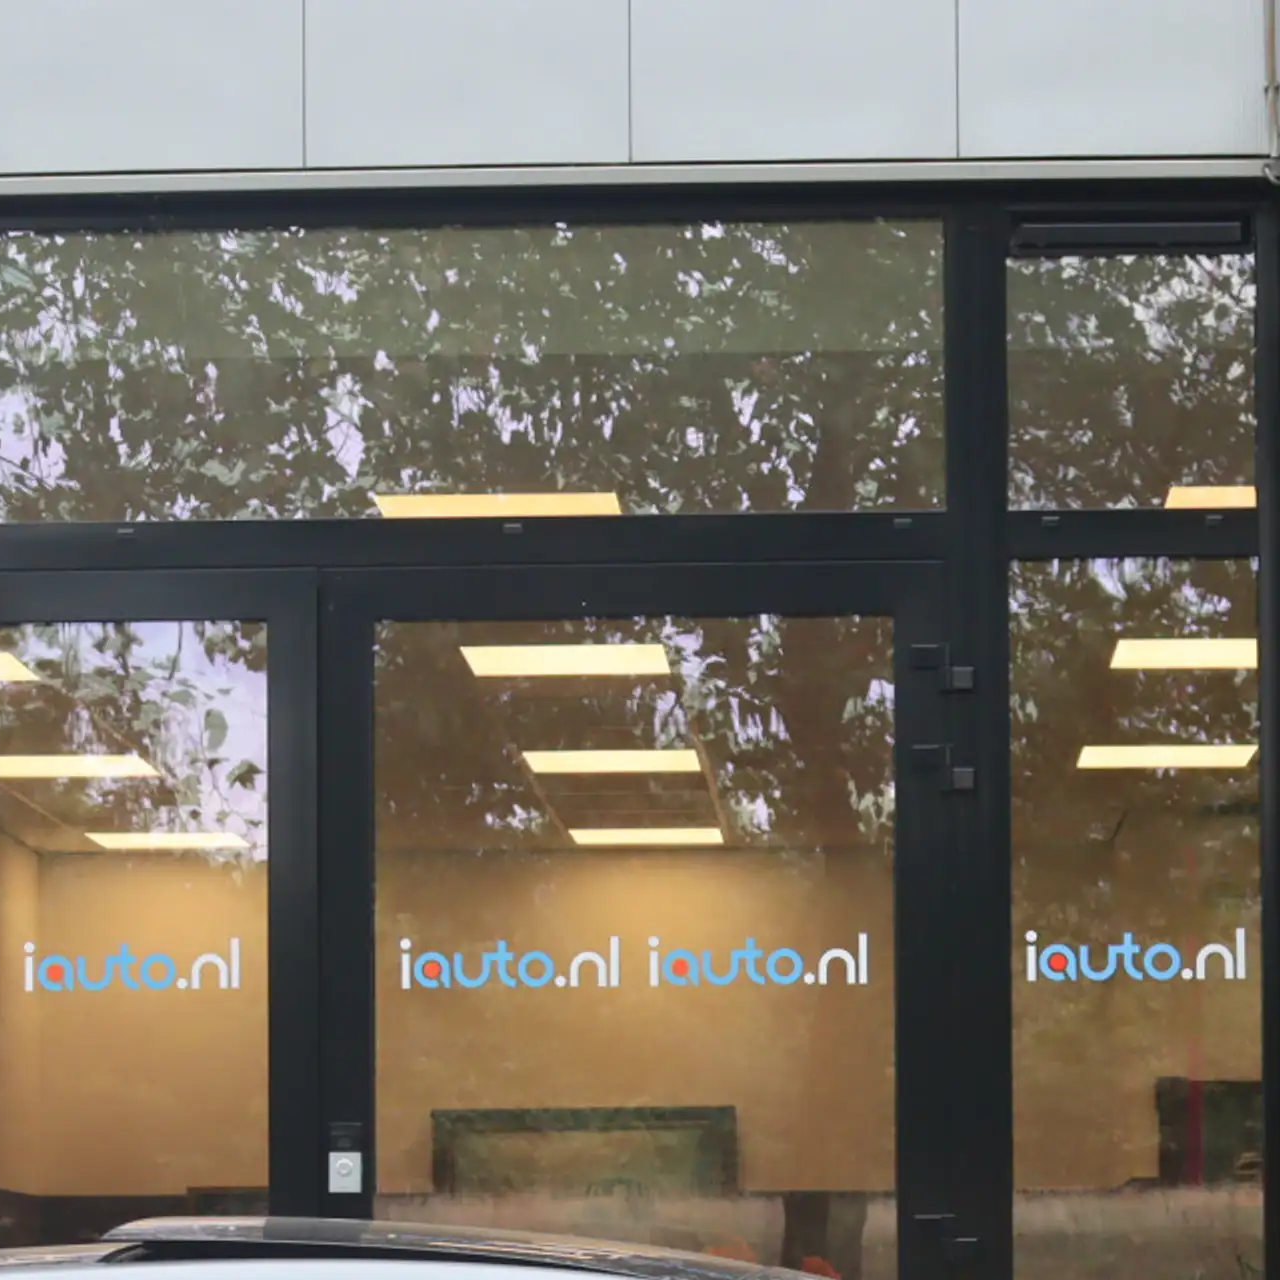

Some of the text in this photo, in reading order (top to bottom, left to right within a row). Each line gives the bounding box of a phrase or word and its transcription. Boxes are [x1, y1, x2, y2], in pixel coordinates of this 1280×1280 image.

[23, 936, 241, 993] iauto.nl
[399, 932, 868, 989] iauto.nl iauto.nl
[1024, 927, 1246, 983] iauto.nl
